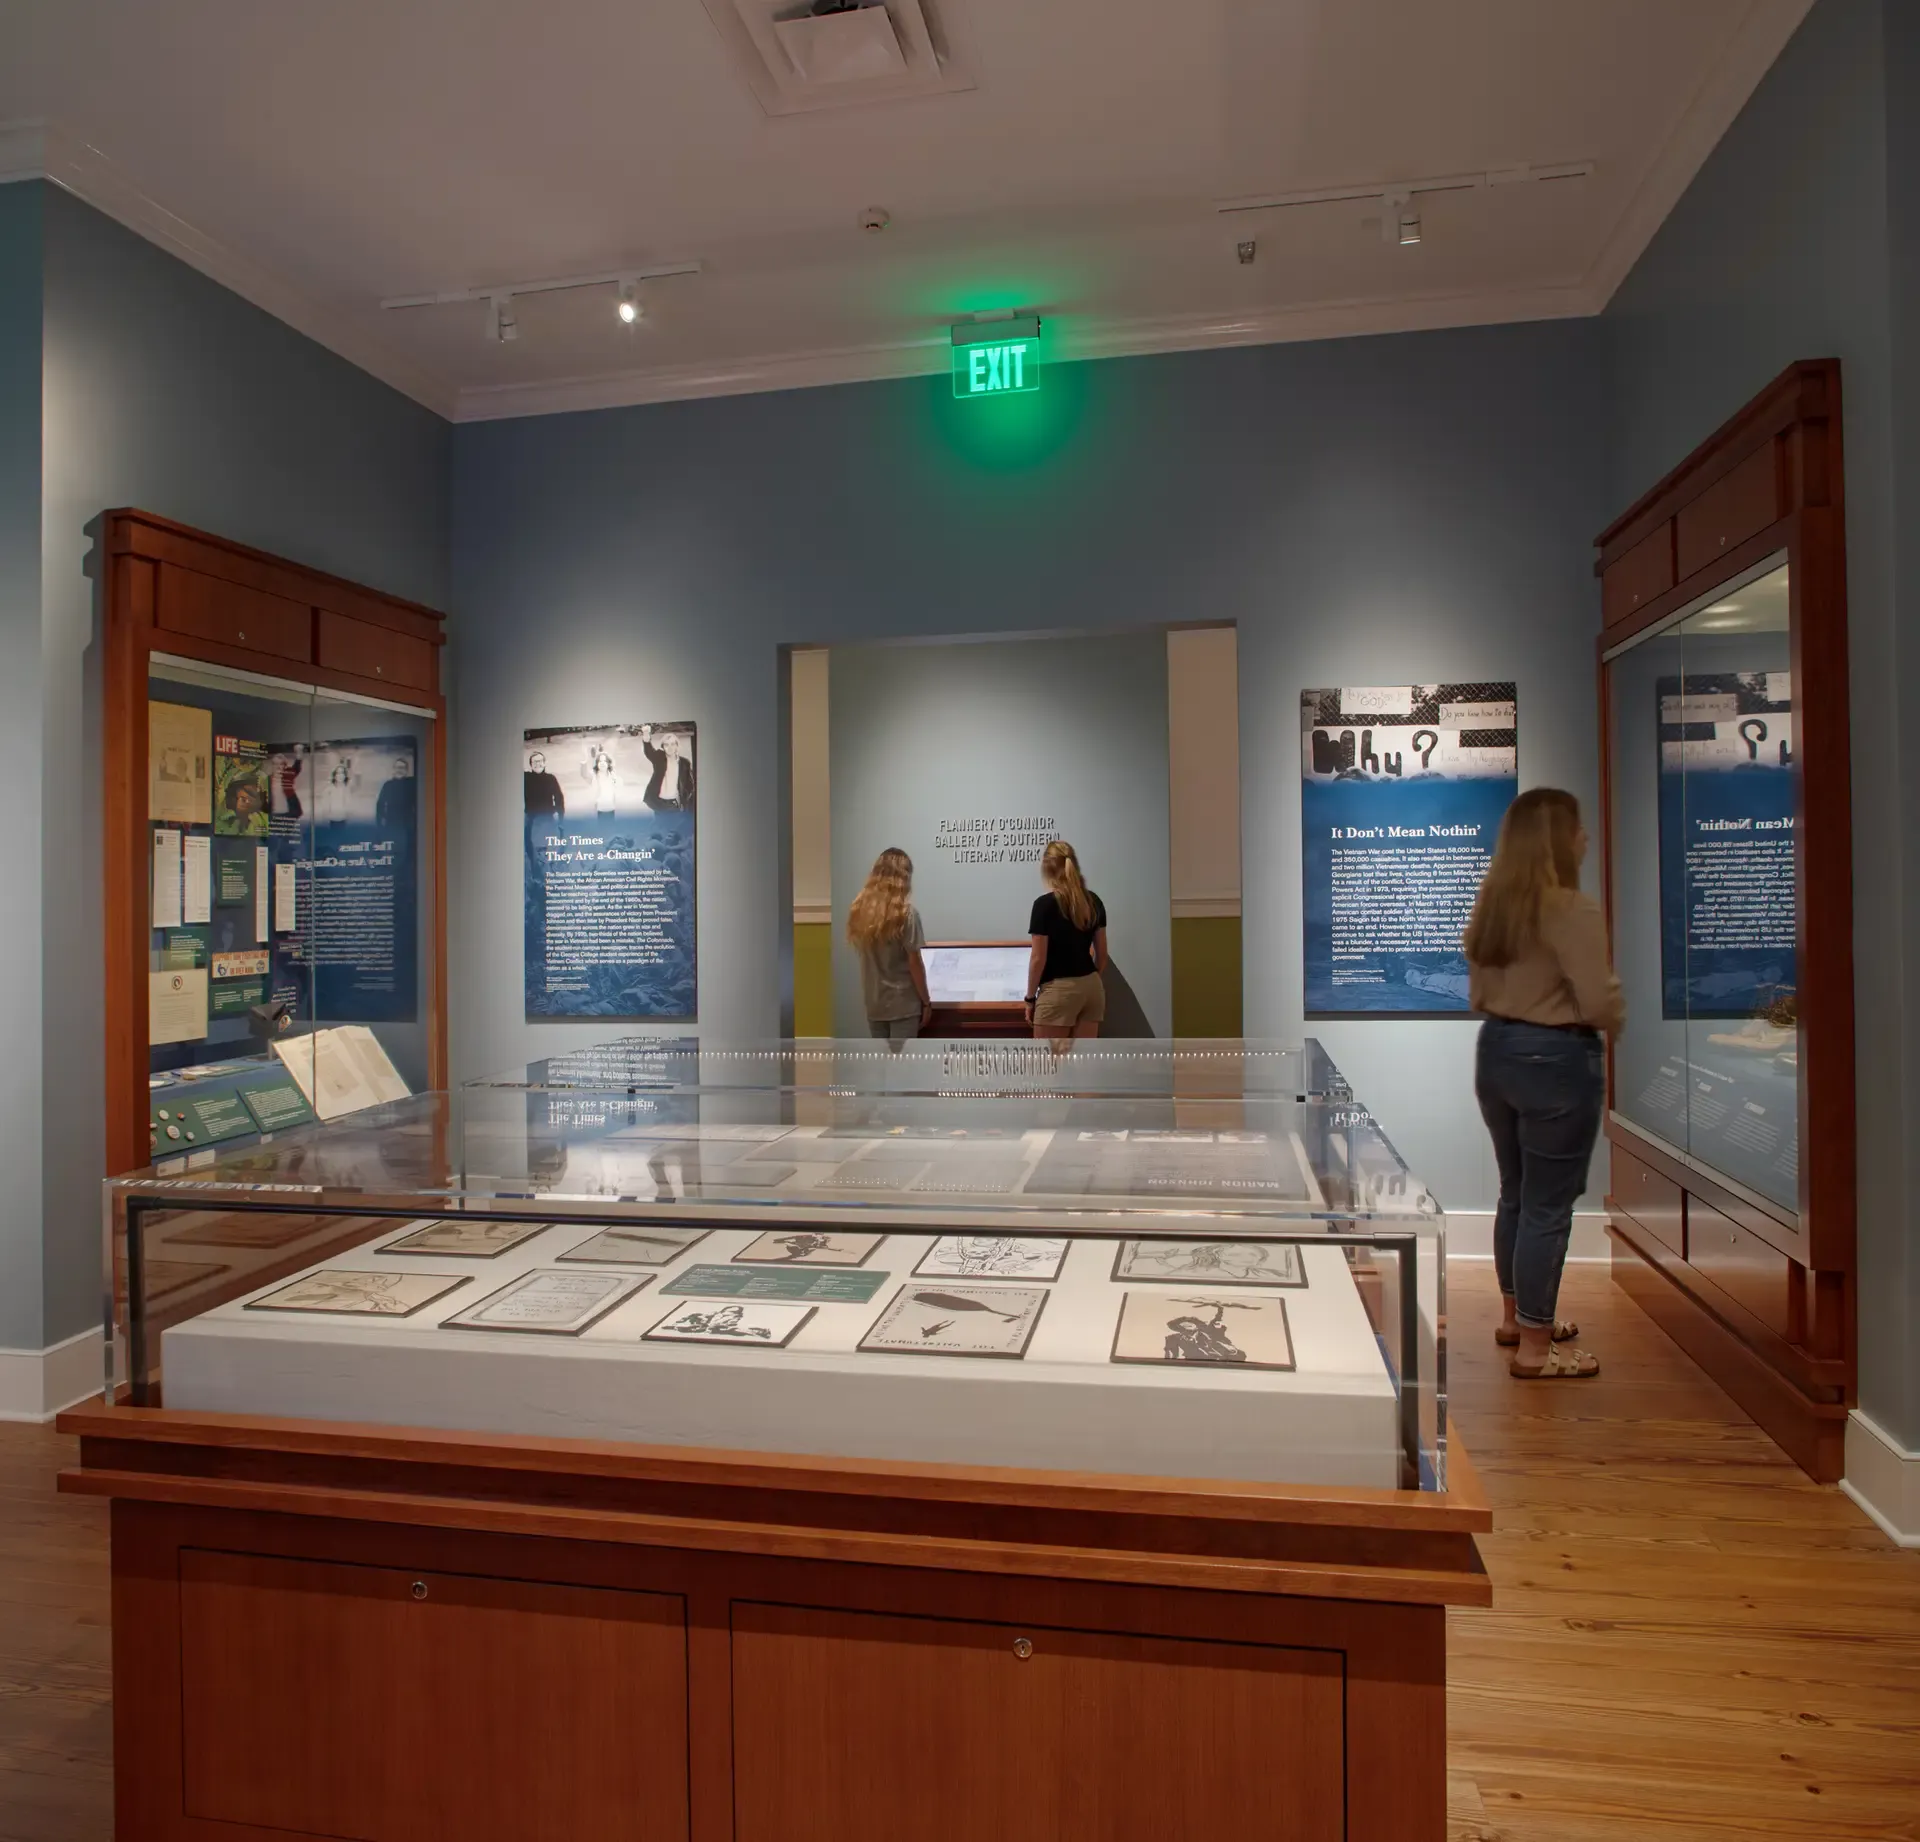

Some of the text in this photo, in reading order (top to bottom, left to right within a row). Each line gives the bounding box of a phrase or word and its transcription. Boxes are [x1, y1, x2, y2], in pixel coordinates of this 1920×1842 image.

[969, 345, 1026, 392] EXIT
[216, 736, 238, 753] LIFE
[940, 817, 1055, 832] FLANNERY O'CONNOR
[1331, 824, 1481, 839] It Don't Mean Nothin'
[545, 835, 604, 846] The Times
[935, 835, 981, 848] GALLERY
[985, 834, 999, 847] OF
[545, 848, 655, 863] They Are a-Changin'
[954, 850, 1004, 863] LITERARY
[1343, 855, 1369, 863] 350,000
[1432, 861, 1474, 870] Approximately
[1332, 871, 1361, 879] Georgians
[1404, 869, 1431, 878] including
[1405, 877, 1434, 885] Congress
[1429, 884, 1456, 892] president
[1435, 899, 1452, 907] 1973,
[1348, 915, 1369, 923] Saigon
[1221, 1179, 1280, 1189] MARION
